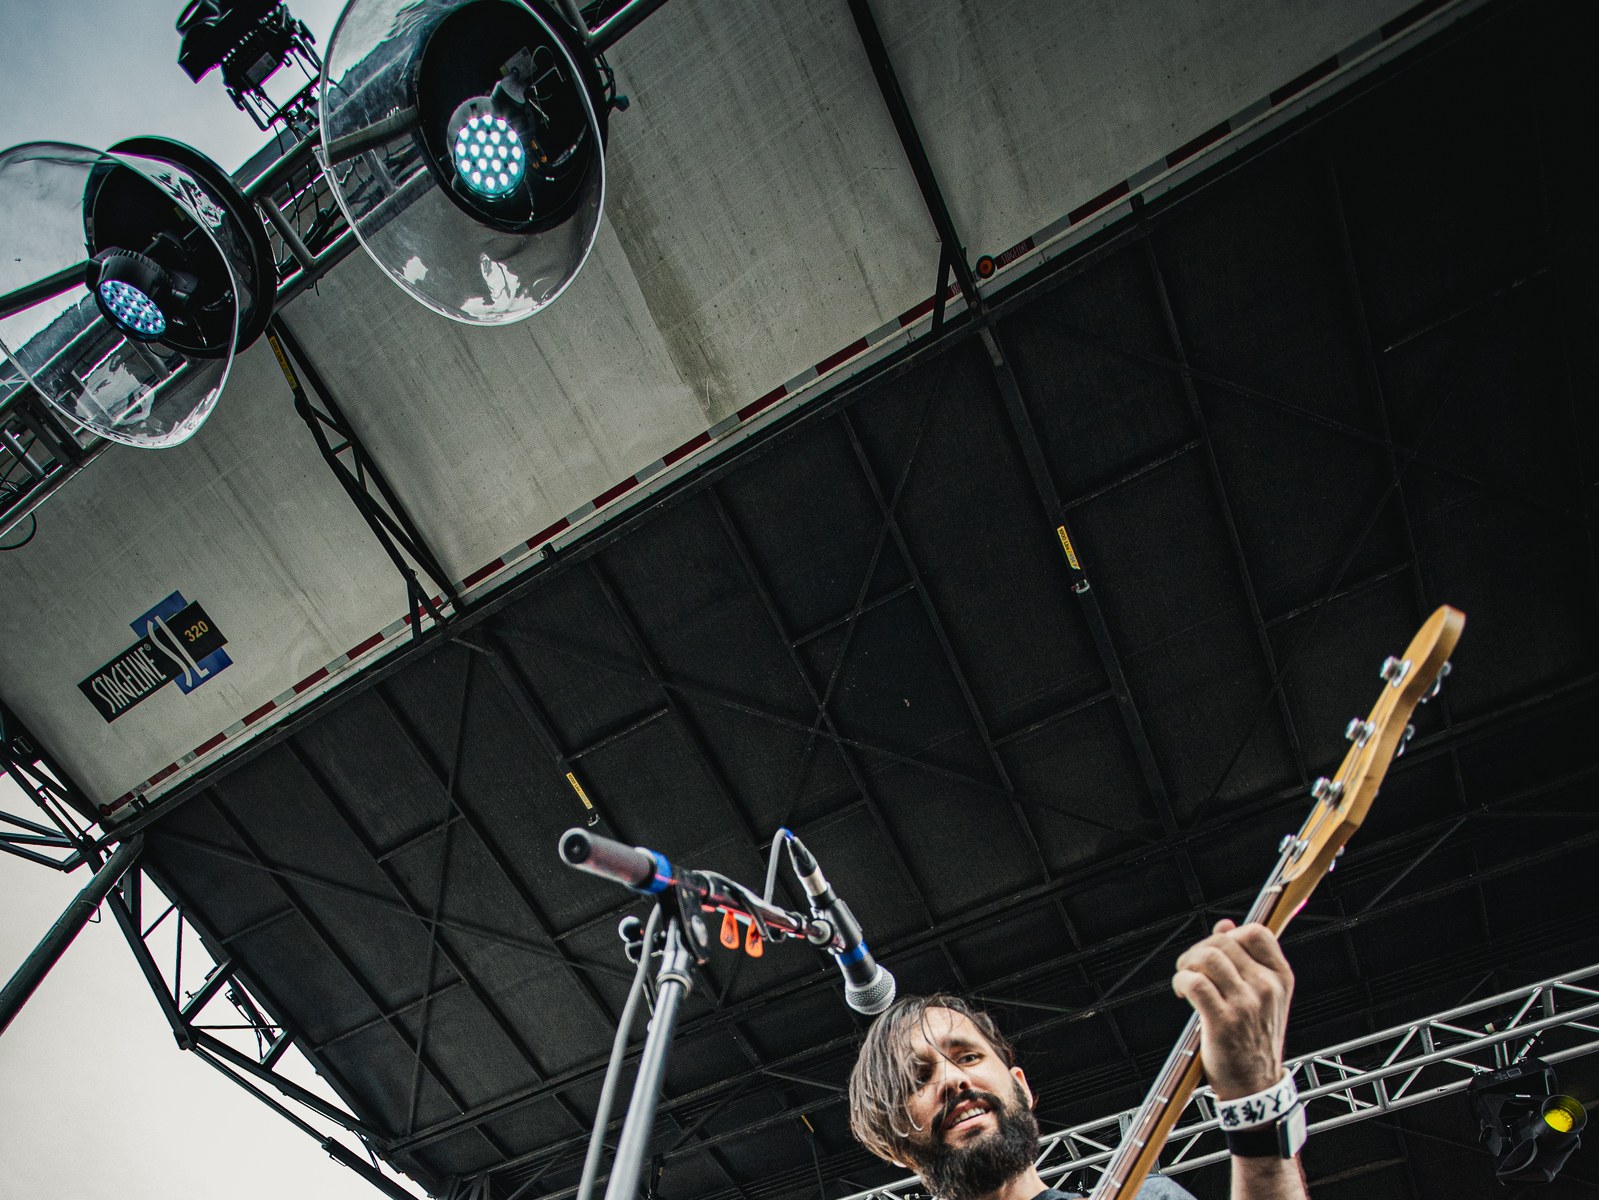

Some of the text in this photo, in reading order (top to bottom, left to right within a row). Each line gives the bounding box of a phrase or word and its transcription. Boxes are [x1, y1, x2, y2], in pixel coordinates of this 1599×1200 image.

[92, 615, 210, 714] STAGELINE SL 320
